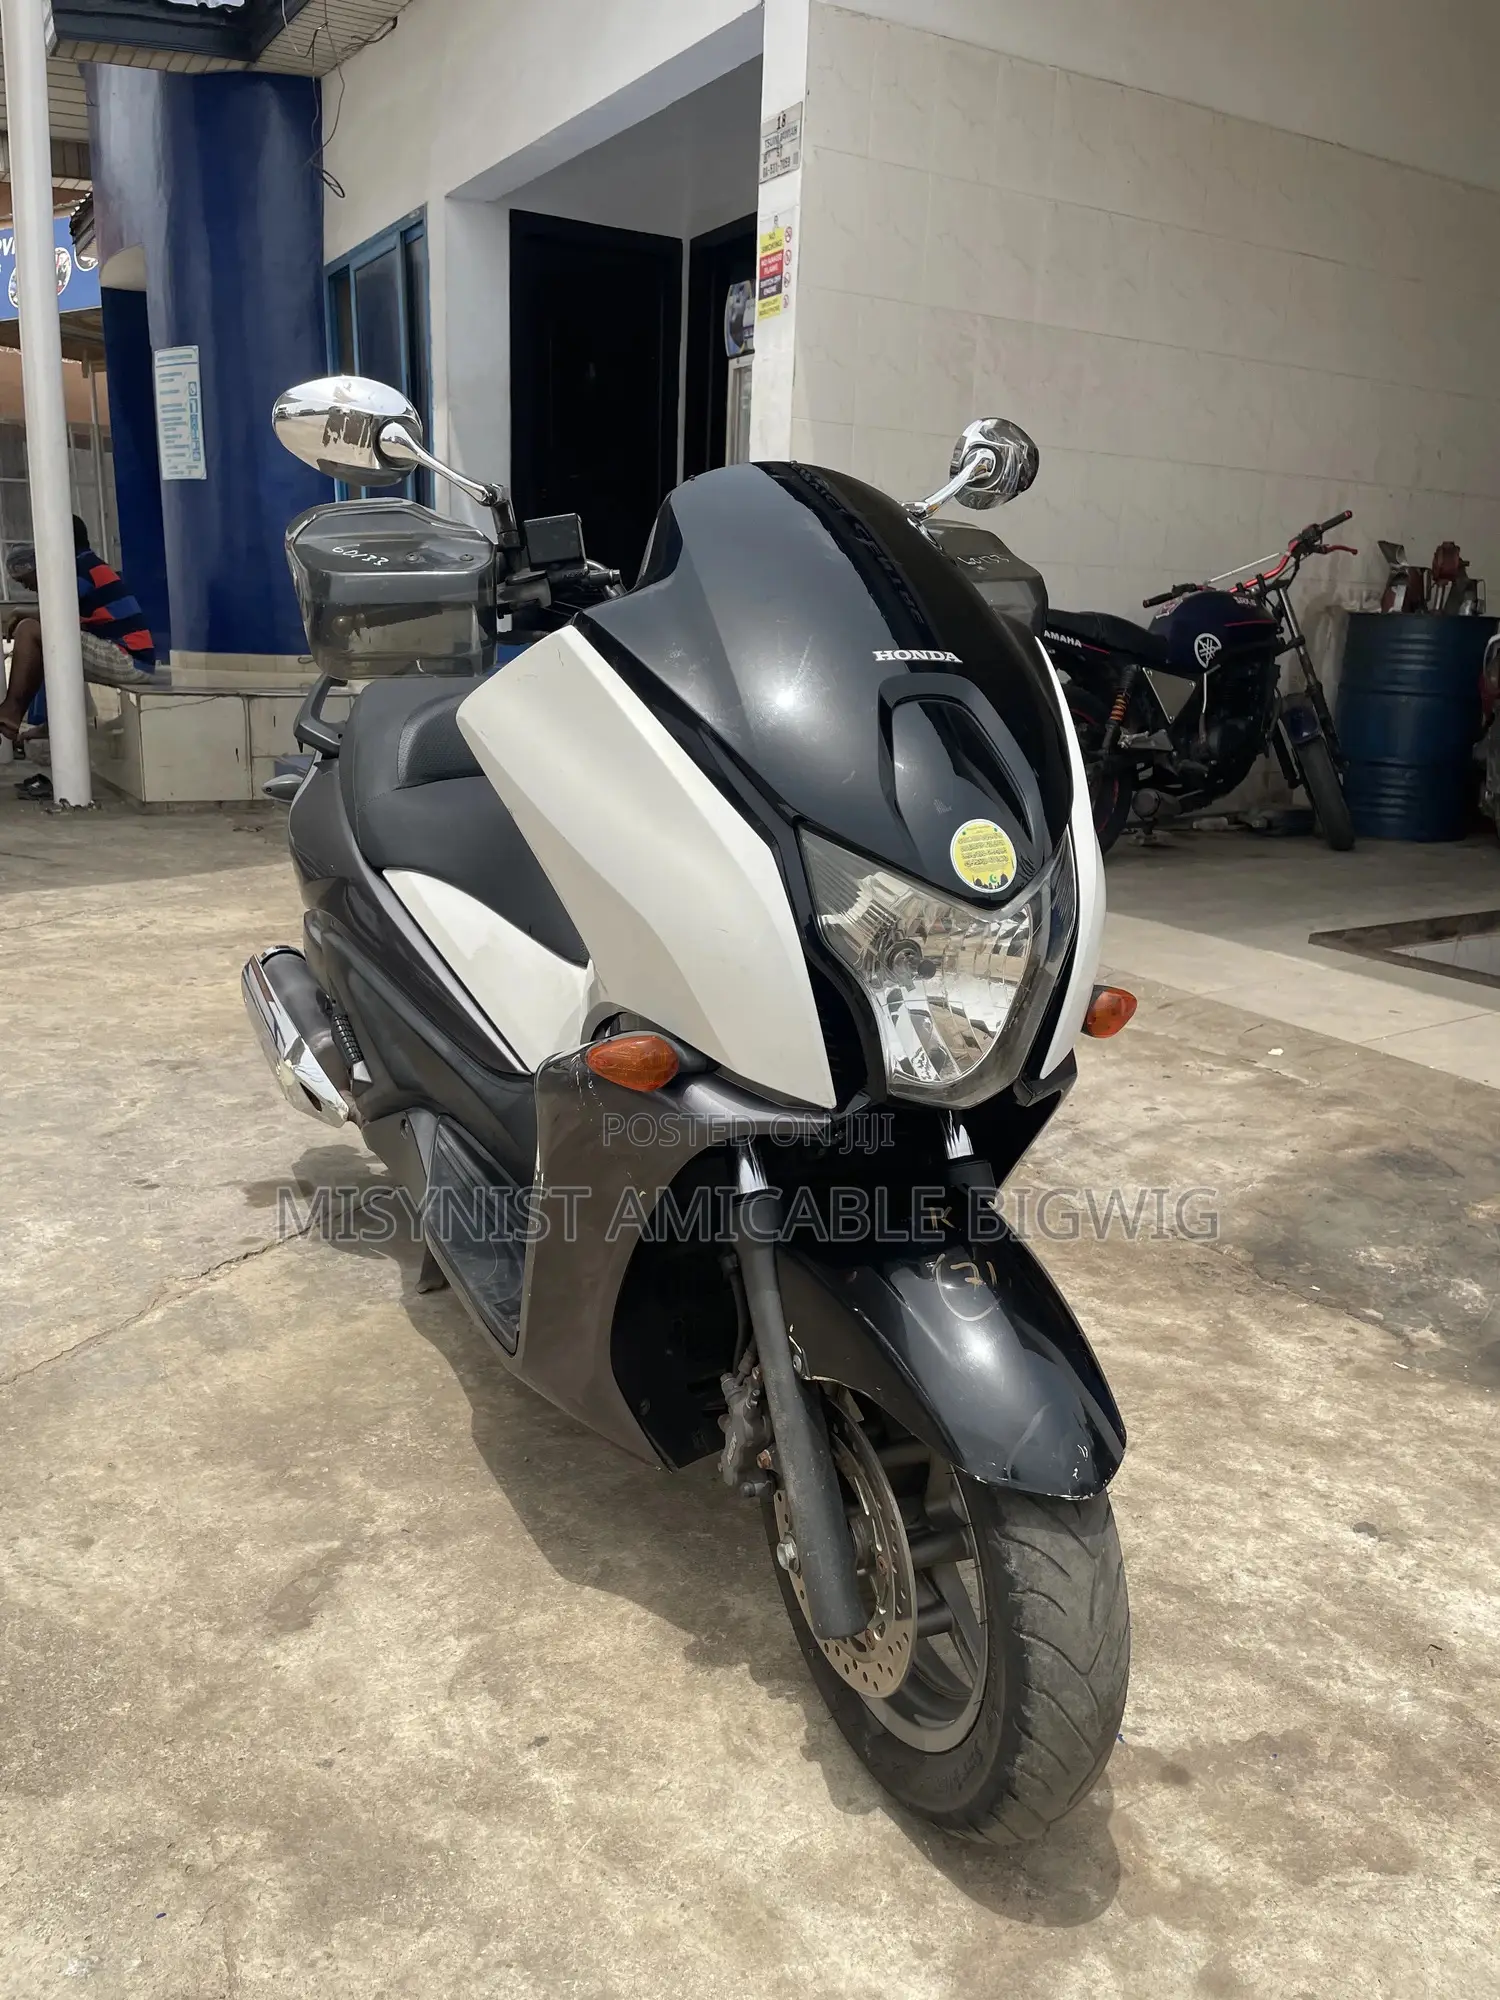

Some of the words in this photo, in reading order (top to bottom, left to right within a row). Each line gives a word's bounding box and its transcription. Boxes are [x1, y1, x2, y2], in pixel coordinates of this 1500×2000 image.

[776, 113, 787, 130] 18
[1043, 629, 1083, 649] AMAHA
[872, 649, 963, 664] HONDA
